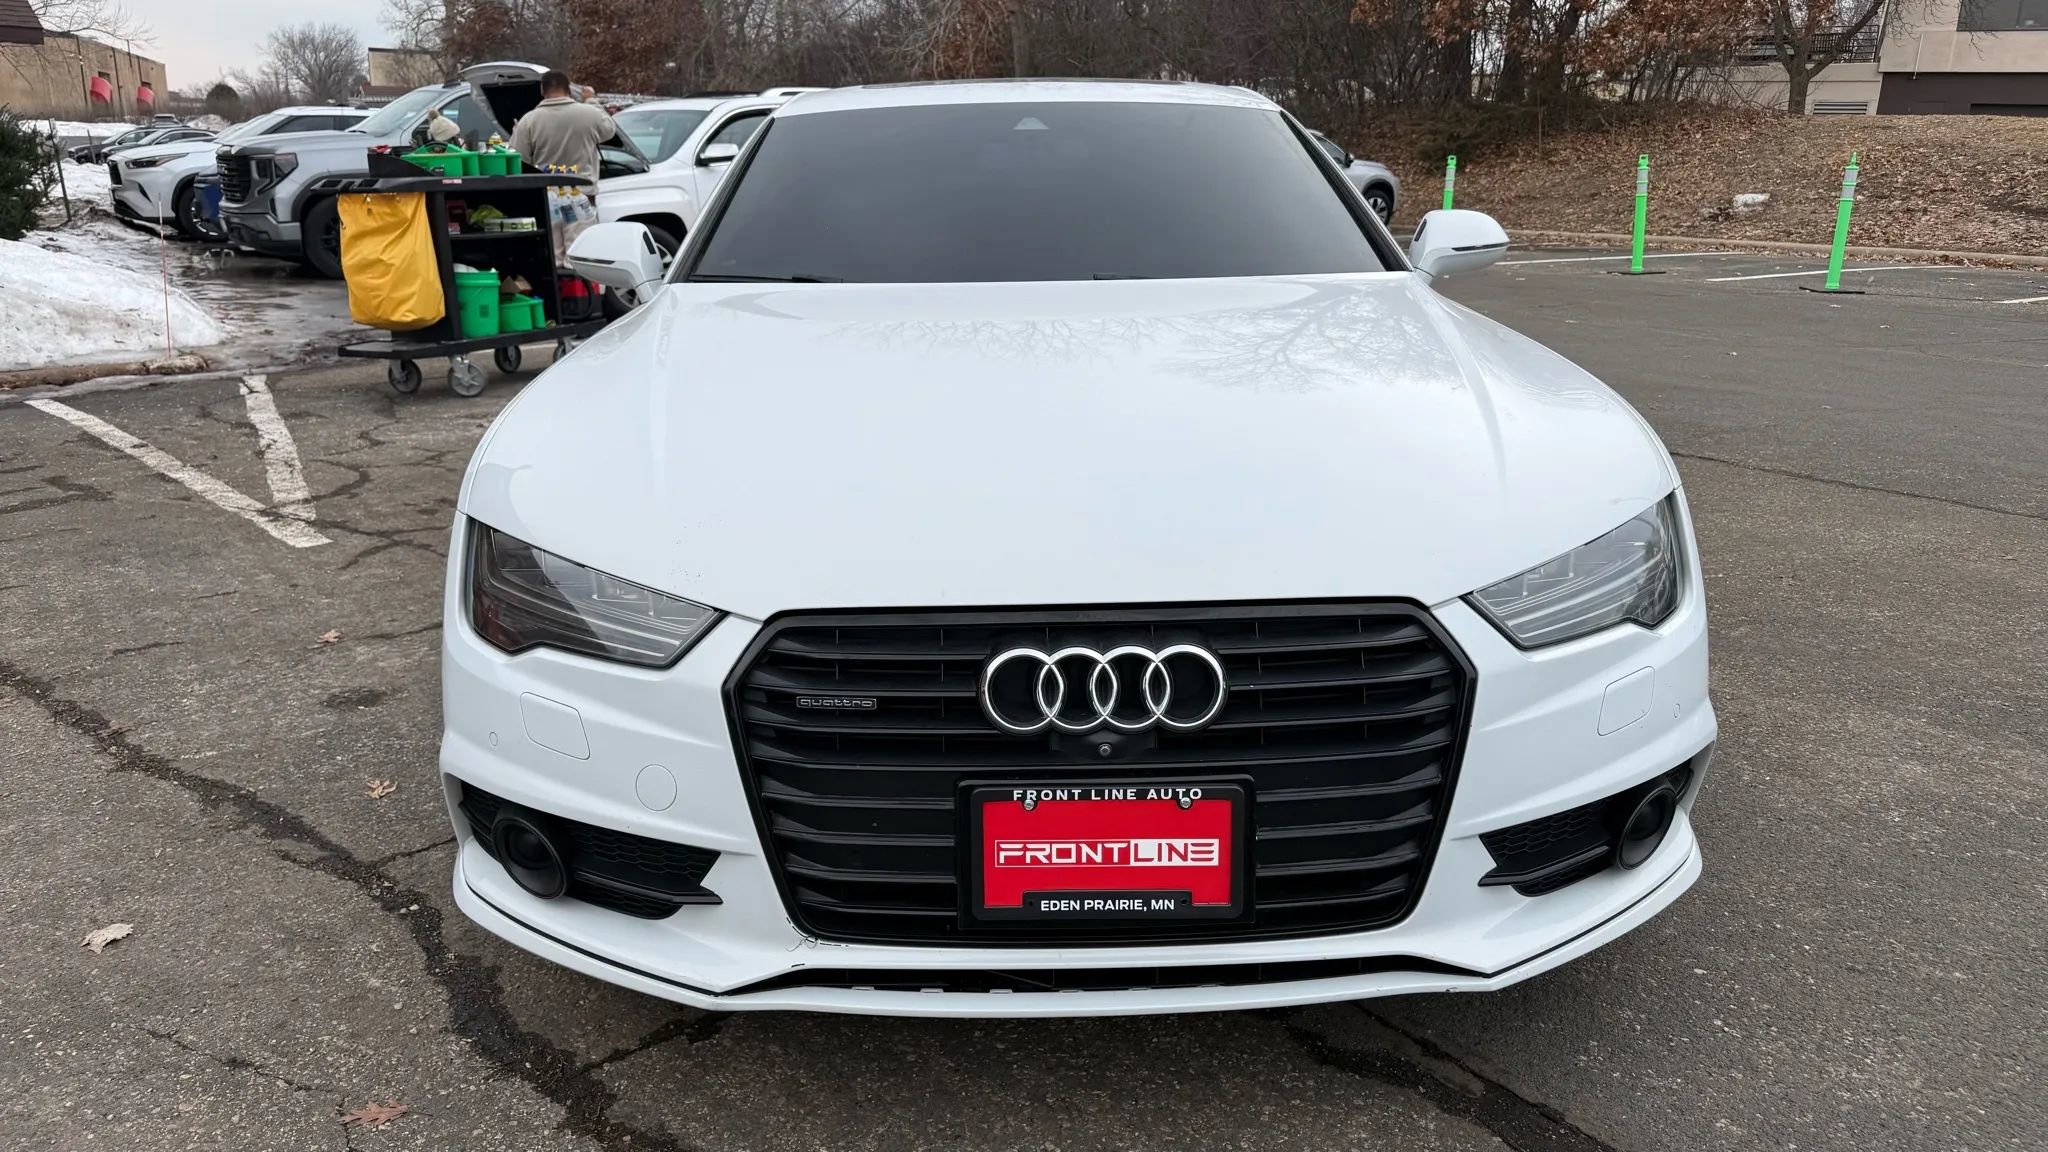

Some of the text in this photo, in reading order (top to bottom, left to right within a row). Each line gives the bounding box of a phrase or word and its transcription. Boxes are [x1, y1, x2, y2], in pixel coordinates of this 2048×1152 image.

[800, 699, 873, 707] quattro
[1013, 788, 1202, 801] FRONT LINE AUTO
[999, 842, 1215, 864] FRONTLINE
[1040, 899, 1175, 911] EDEN PRAIRIE, MN
